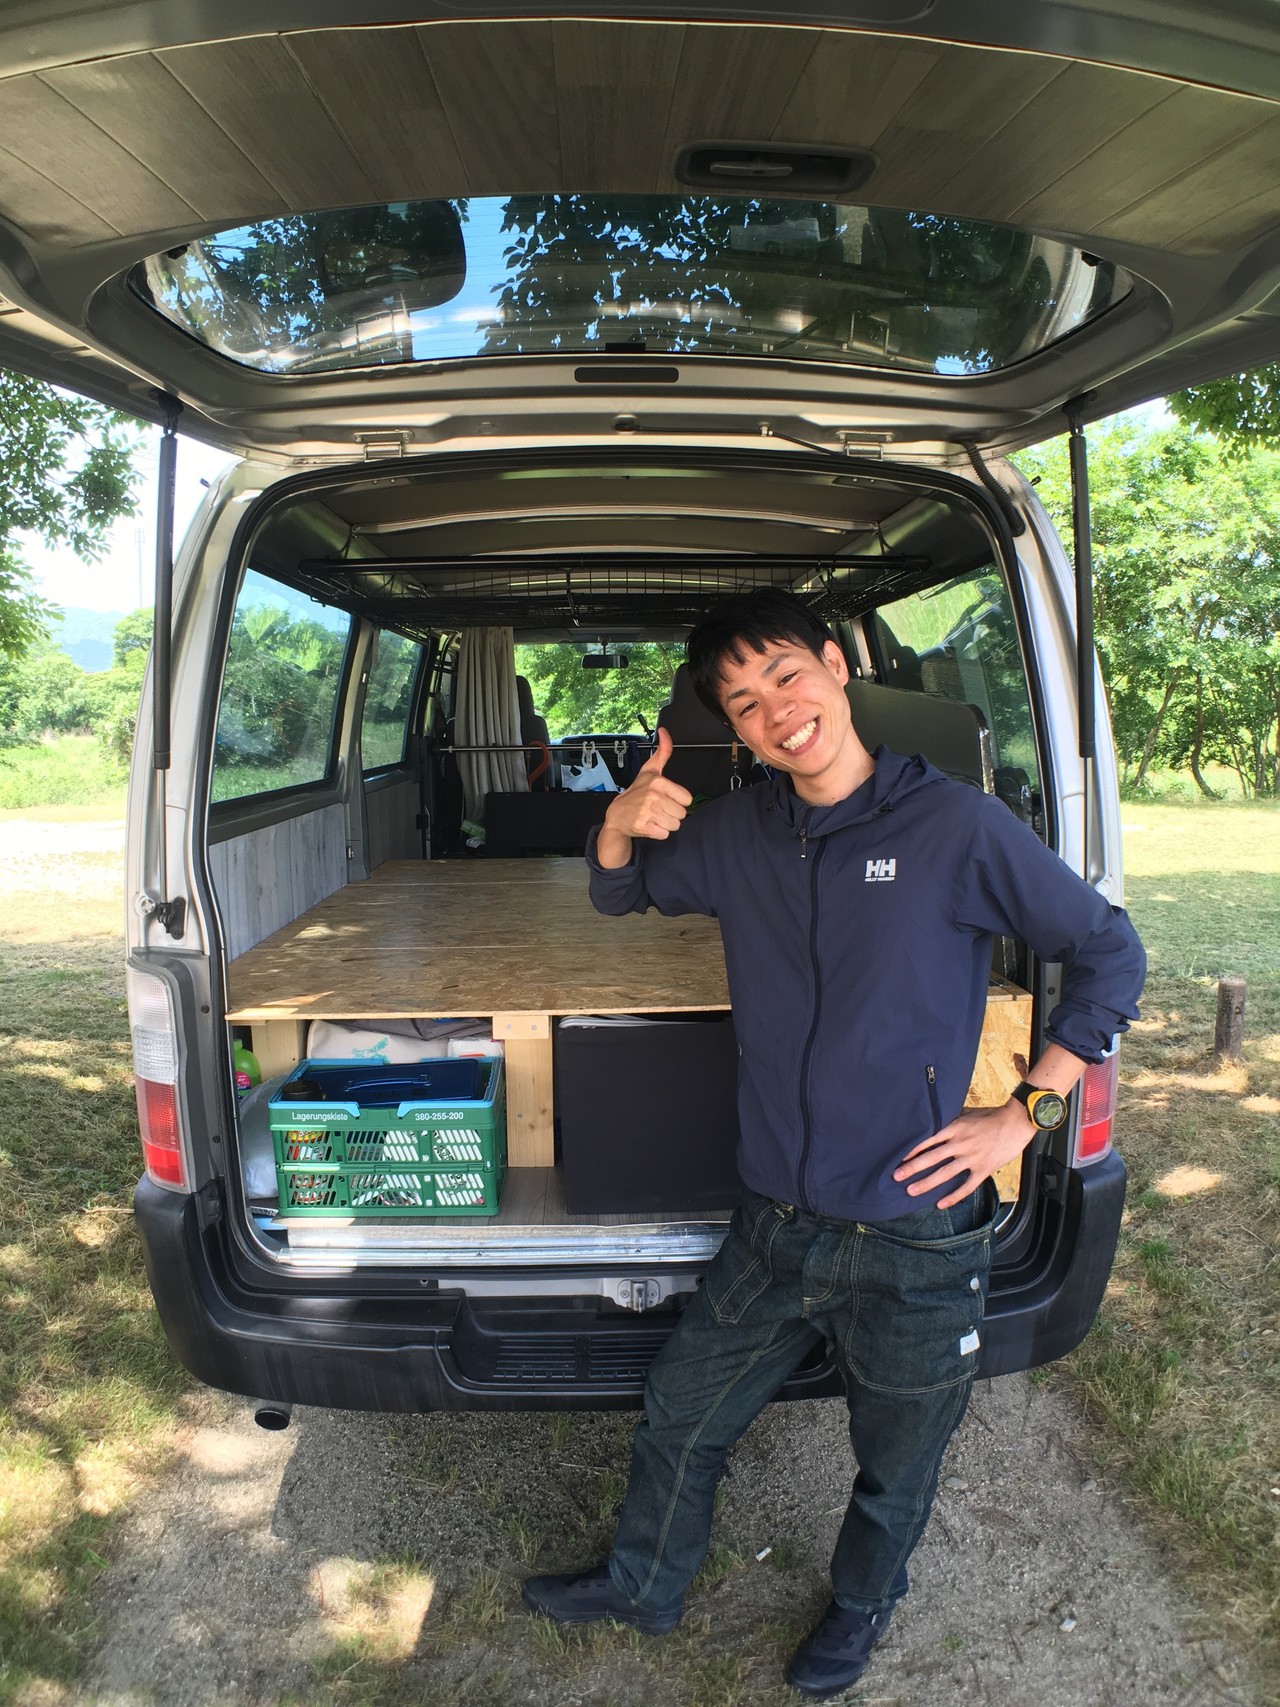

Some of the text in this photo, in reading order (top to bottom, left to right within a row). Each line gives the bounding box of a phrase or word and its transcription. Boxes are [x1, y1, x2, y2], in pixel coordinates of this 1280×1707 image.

[865, 858, 896, 877] HH
[291, 1111, 349, 1122] Lagerungskiste
[414, 1111, 464, 1121] 380-255-200
